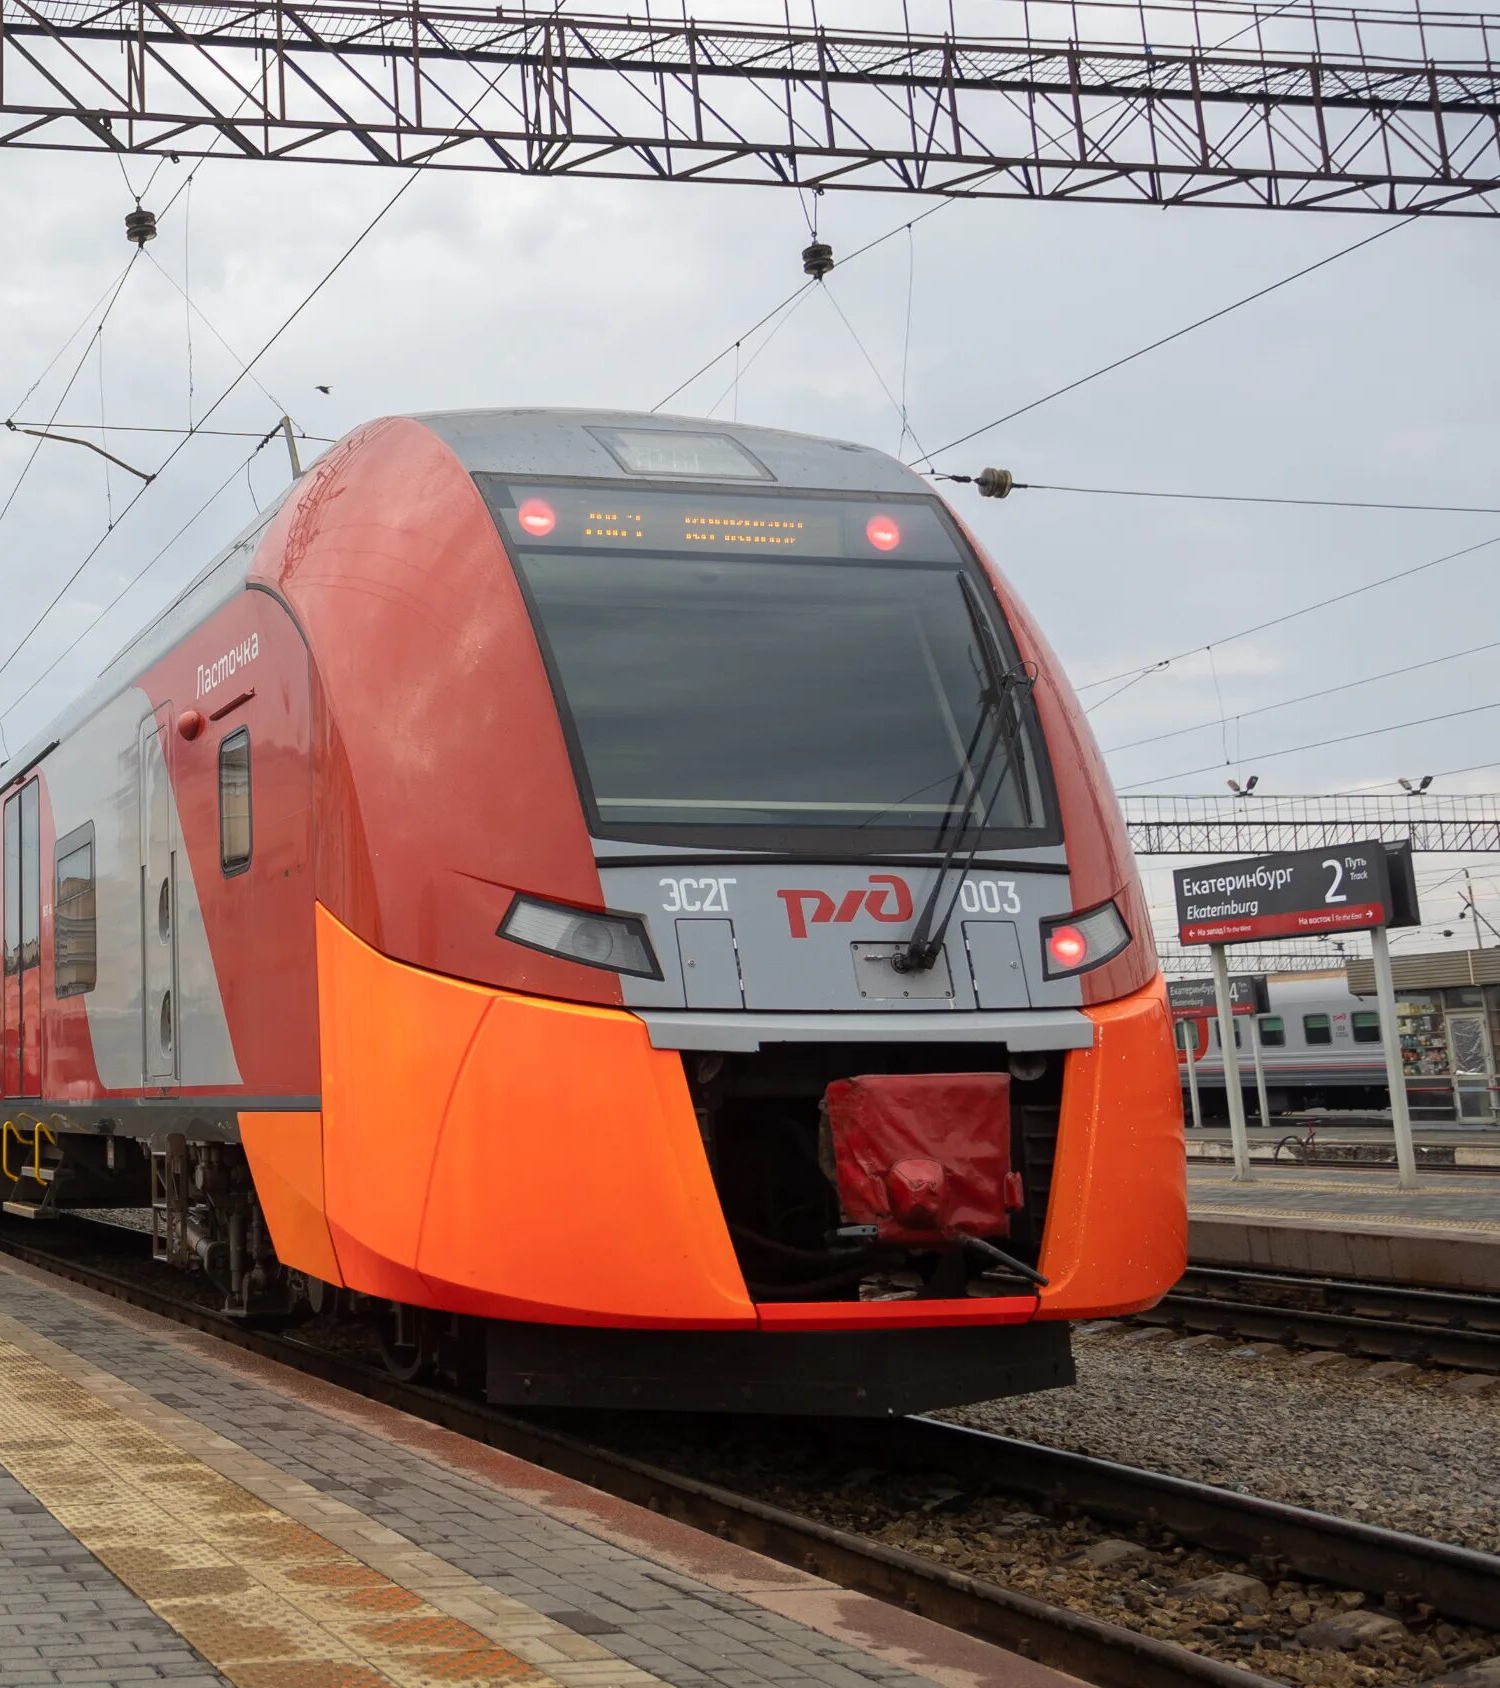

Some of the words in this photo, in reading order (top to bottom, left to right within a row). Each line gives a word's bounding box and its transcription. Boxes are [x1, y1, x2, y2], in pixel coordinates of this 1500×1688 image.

[196, 632, 259, 700] Ласточка
[1345, 857, 1367, 869] Путь
[1183, 866, 1294, 896] Екатеринбург
[1321, 859, 1347, 903] 2
[1350, 872, 1369, 881] Track
[659, 878, 737, 912] ЭС2Г
[960, 880, 1020, 914] 003
[1187, 901, 1259, 920] Ekaterinburg
[1298, 917, 1308, 926] На
[1308, 916, 1332, 925] восток
[1229, 983, 1239, 1002] 4
